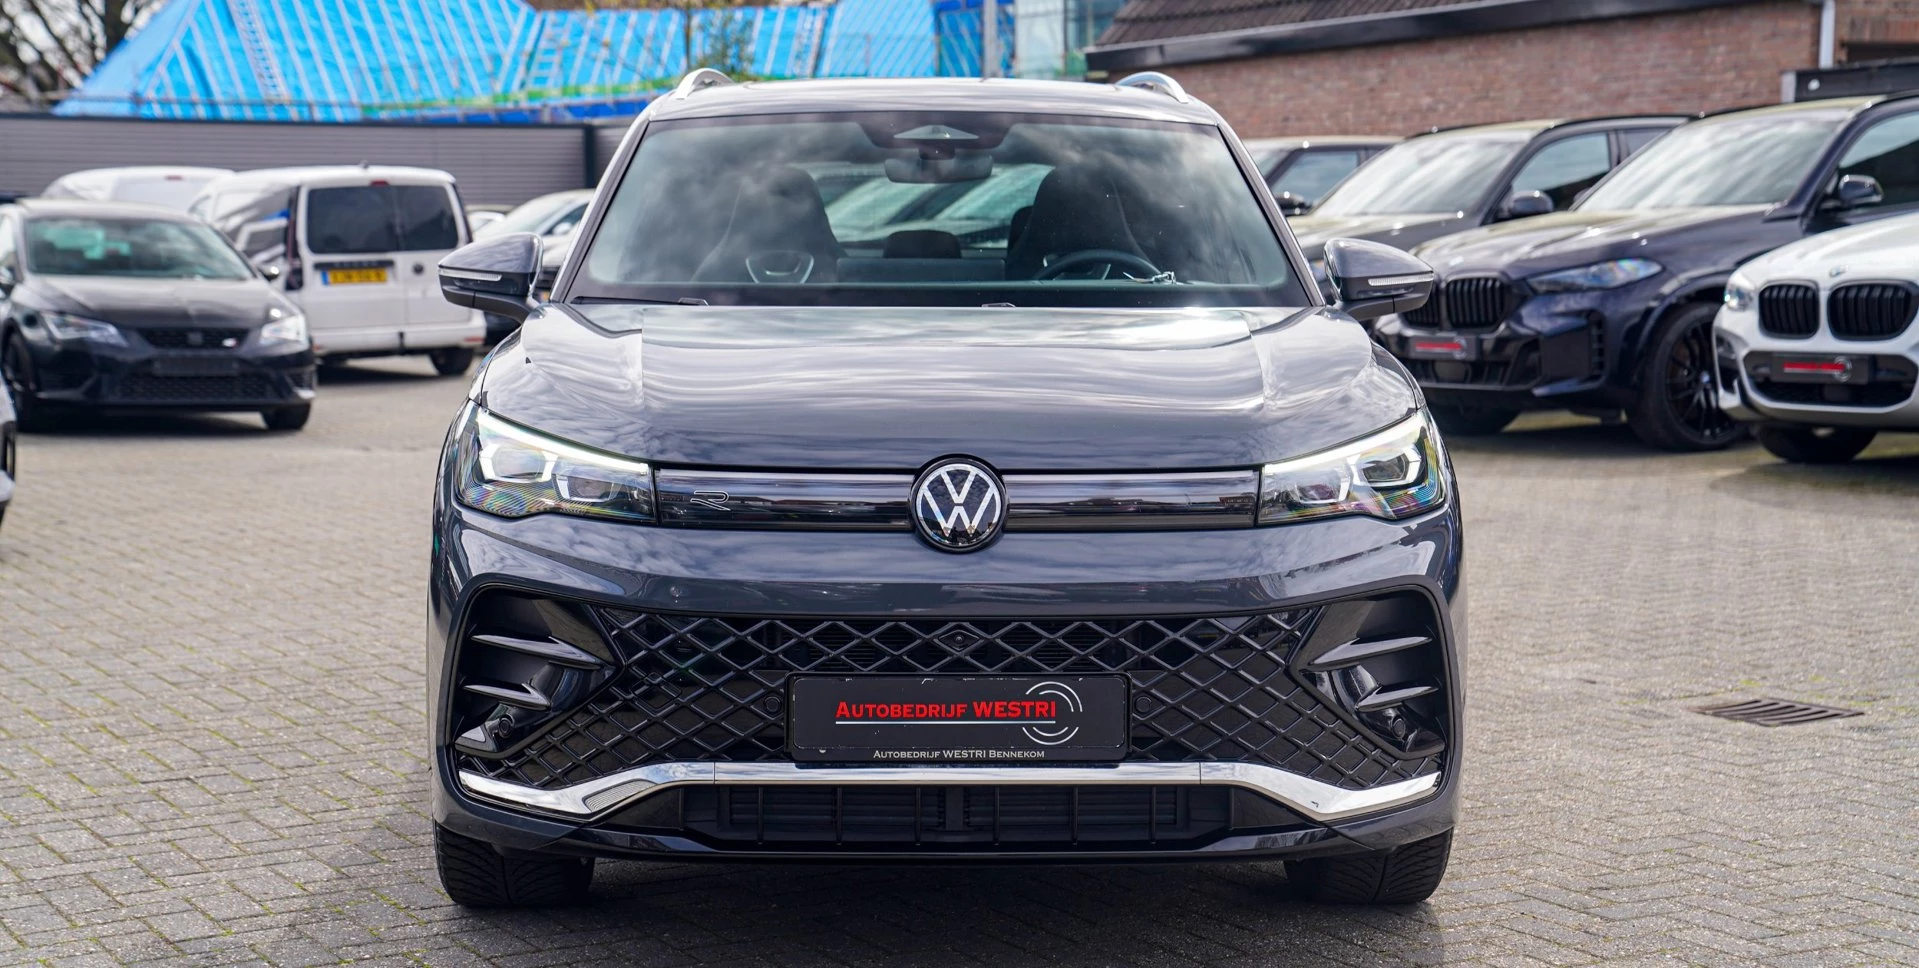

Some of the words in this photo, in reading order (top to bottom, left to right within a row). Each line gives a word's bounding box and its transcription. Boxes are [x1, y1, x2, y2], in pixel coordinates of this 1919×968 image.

[835, 701, 968, 718] AUTOBEDRIJF
[972, 700, 1057, 718] WESTRI
[873, 750, 941, 759] AUTOBEDRIJF
[942, 750, 987, 759] WESTRI
[988, 750, 1045, 758] BENNEKOM
